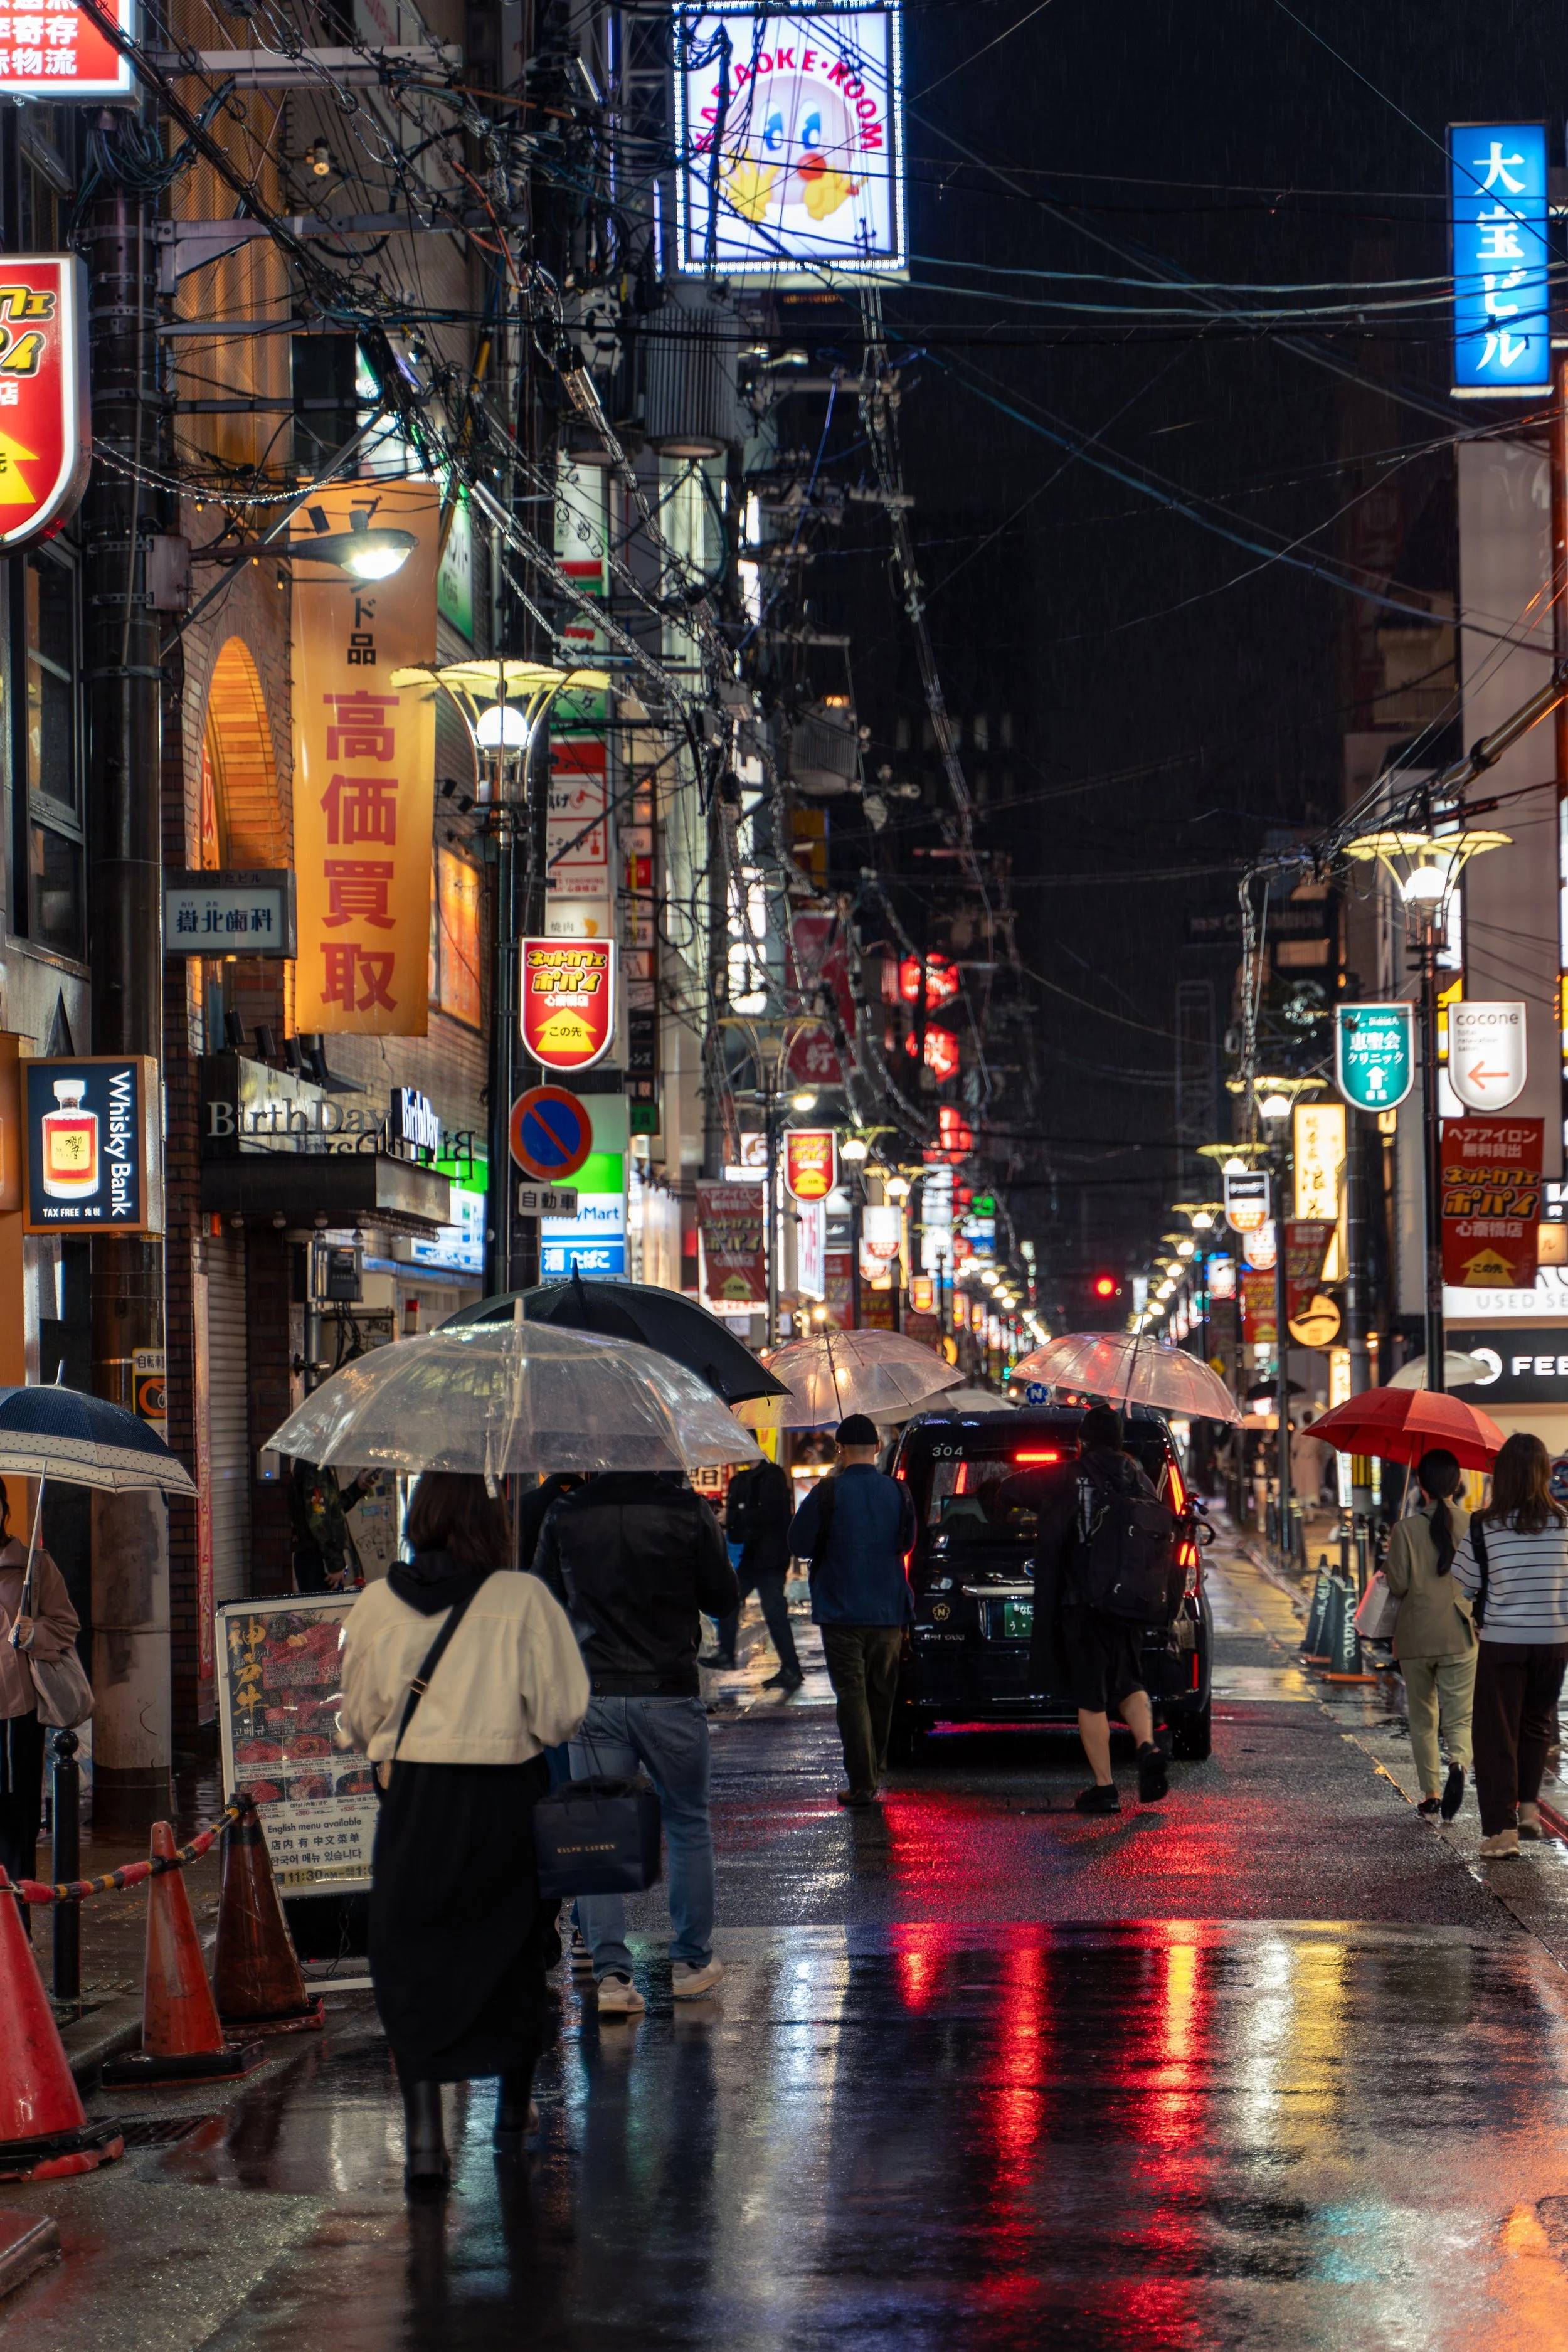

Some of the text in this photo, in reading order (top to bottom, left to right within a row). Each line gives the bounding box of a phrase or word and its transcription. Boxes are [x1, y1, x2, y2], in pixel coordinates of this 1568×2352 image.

[1472, 141, 1528, 371] 大宝ビル
[319, 690, 398, 1013] 高価買取
[528, 951, 606, 968] ネットカフェ
[533, 970, 601, 993] ポパイ
[1456, 1012, 1519, 1026] cocone
[549, 1027, 582, 1037] この先
[1347, 1051, 1404, 1066] クリニック
[206, 1098, 391, 1138] BirthDay
[103, 1070, 132, 1217] Whisky Bank
[1448, 1128, 1537, 1143] ヘアアイロン
[1462, 1143, 1522, 1158] 無料貸出
[1444, 1167, 1540, 1187] ネットカフェ
[522, 1190, 575, 1211] 自動車
[1444, 1189, 1538, 1219] ポパイ
[43, 1208, 58, 1217] TAX
[60, 1208, 79, 1217] FREE
[1455, 1221, 1523, 1238] 心斎橋店
[569, 1249, 611, 1269] たばこ
[1472, 1264, 1504, 1274] この先
[1476, 1293, 1535, 1310] USED
[931, 1445, 964, 1458] 304
[228, 1616, 270, 1724] 神戸牛
[233, 1725, 266, 1737] 고베규
[268, 1823, 295, 1835] English
[324, 1817, 361, 1829] available
[271, 1833, 360, 1851] 店内 有 中文菜单
[556, 1843, 616, 1854] RALPH LAUREN
[270, 1848, 362, 1867] 한국어 메뉴 있습니다
